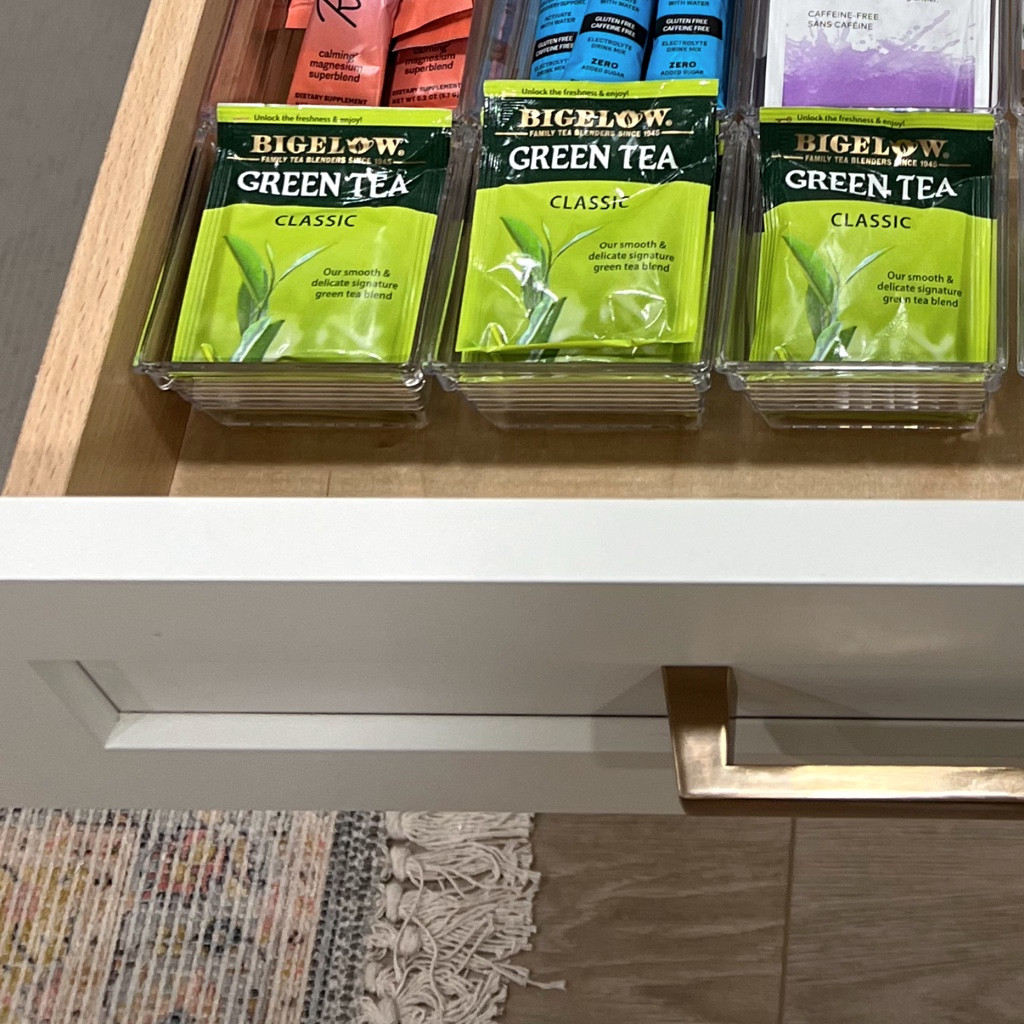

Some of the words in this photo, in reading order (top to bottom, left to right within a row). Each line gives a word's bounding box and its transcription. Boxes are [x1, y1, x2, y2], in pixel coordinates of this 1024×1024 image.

[808, 11, 879, 20] CAFFEINE-FREE
[834, 21, 873, 30] CAFÉINE
[310, 60, 363, 72] magnesium
[309, 71, 360, 83] superblend
[254, 114, 280, 122] Unlock
[282, 114, 294, 122] the
[296, 114, 331, 122] freshness
[340, 116, 362, 125] enjoy!
[519, 108, 672, 128] BIGELOW
[250, 135, 404, 156] BIGELOW
[794, 133, 949, 158] BIGELOW
[509, 145, 610, 170] GREEN
[618, 145, 680, 170] TEA
[237, 169, 341, 197] GREEN
[345, 169, 409, 198] TEA
[785, 169, 891, 199] GREEN
[896, 175, 957, 201] TEA
[549, 195, 630, 210] CLASSIC
[275, 215, 357, 227] CLASSIC
[831, 212, 912, 229] CLASSIC
[599, 241, 618, 249] Our
[620, 240, 657, 249] smooth
[659, 241, 666, 249] &
[588, 251, 627, 261] delicate
[629, 251, 675, 263] signature
[593, 264, 622, 273] green
[624, 263, 639, 271] tea
[642, 262, 670, 272] blend
[887, 271, 905, 281] Our
[907, 273, 945, 283] smooth
[946, 275, 954, 284] &
[877, 282, 915, 293] delicate
[917, 285, 962, 297] signature
[883, 295, 911, 305] green
[913, 296, 929, 305] tea
[931, 296, 959, 307] blend
